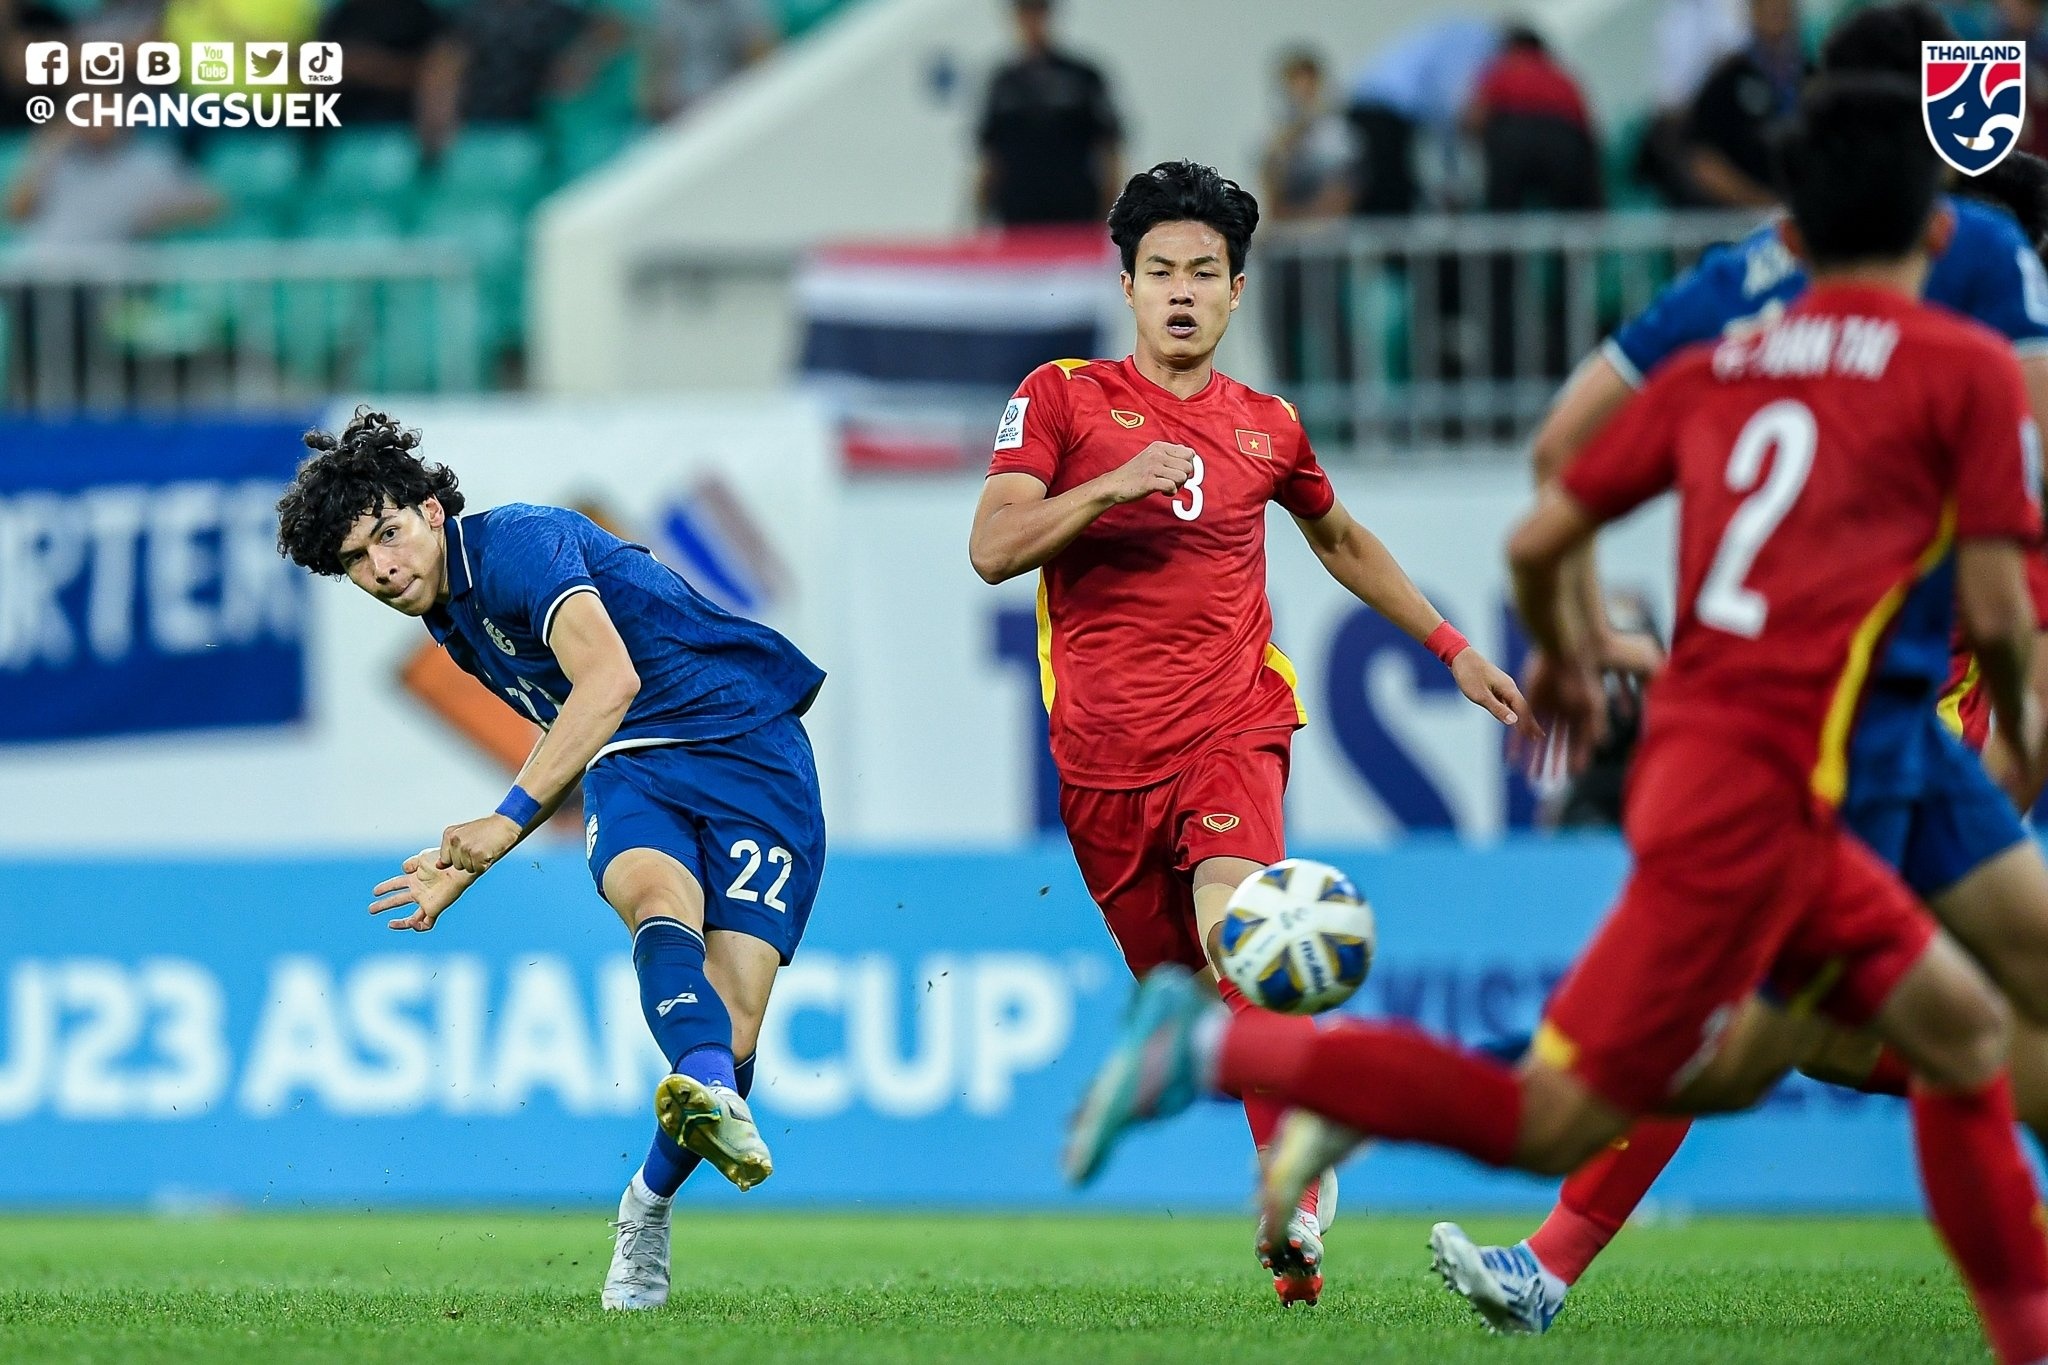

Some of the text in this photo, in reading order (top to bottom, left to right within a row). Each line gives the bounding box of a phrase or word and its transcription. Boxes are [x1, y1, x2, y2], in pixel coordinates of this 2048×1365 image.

[1172, 453, 1205, 521] 3
[1694, 398, 1820, 640] 2
[726, 839, 792, 914] 22
[756, 953, 1076, 1118] CUP
